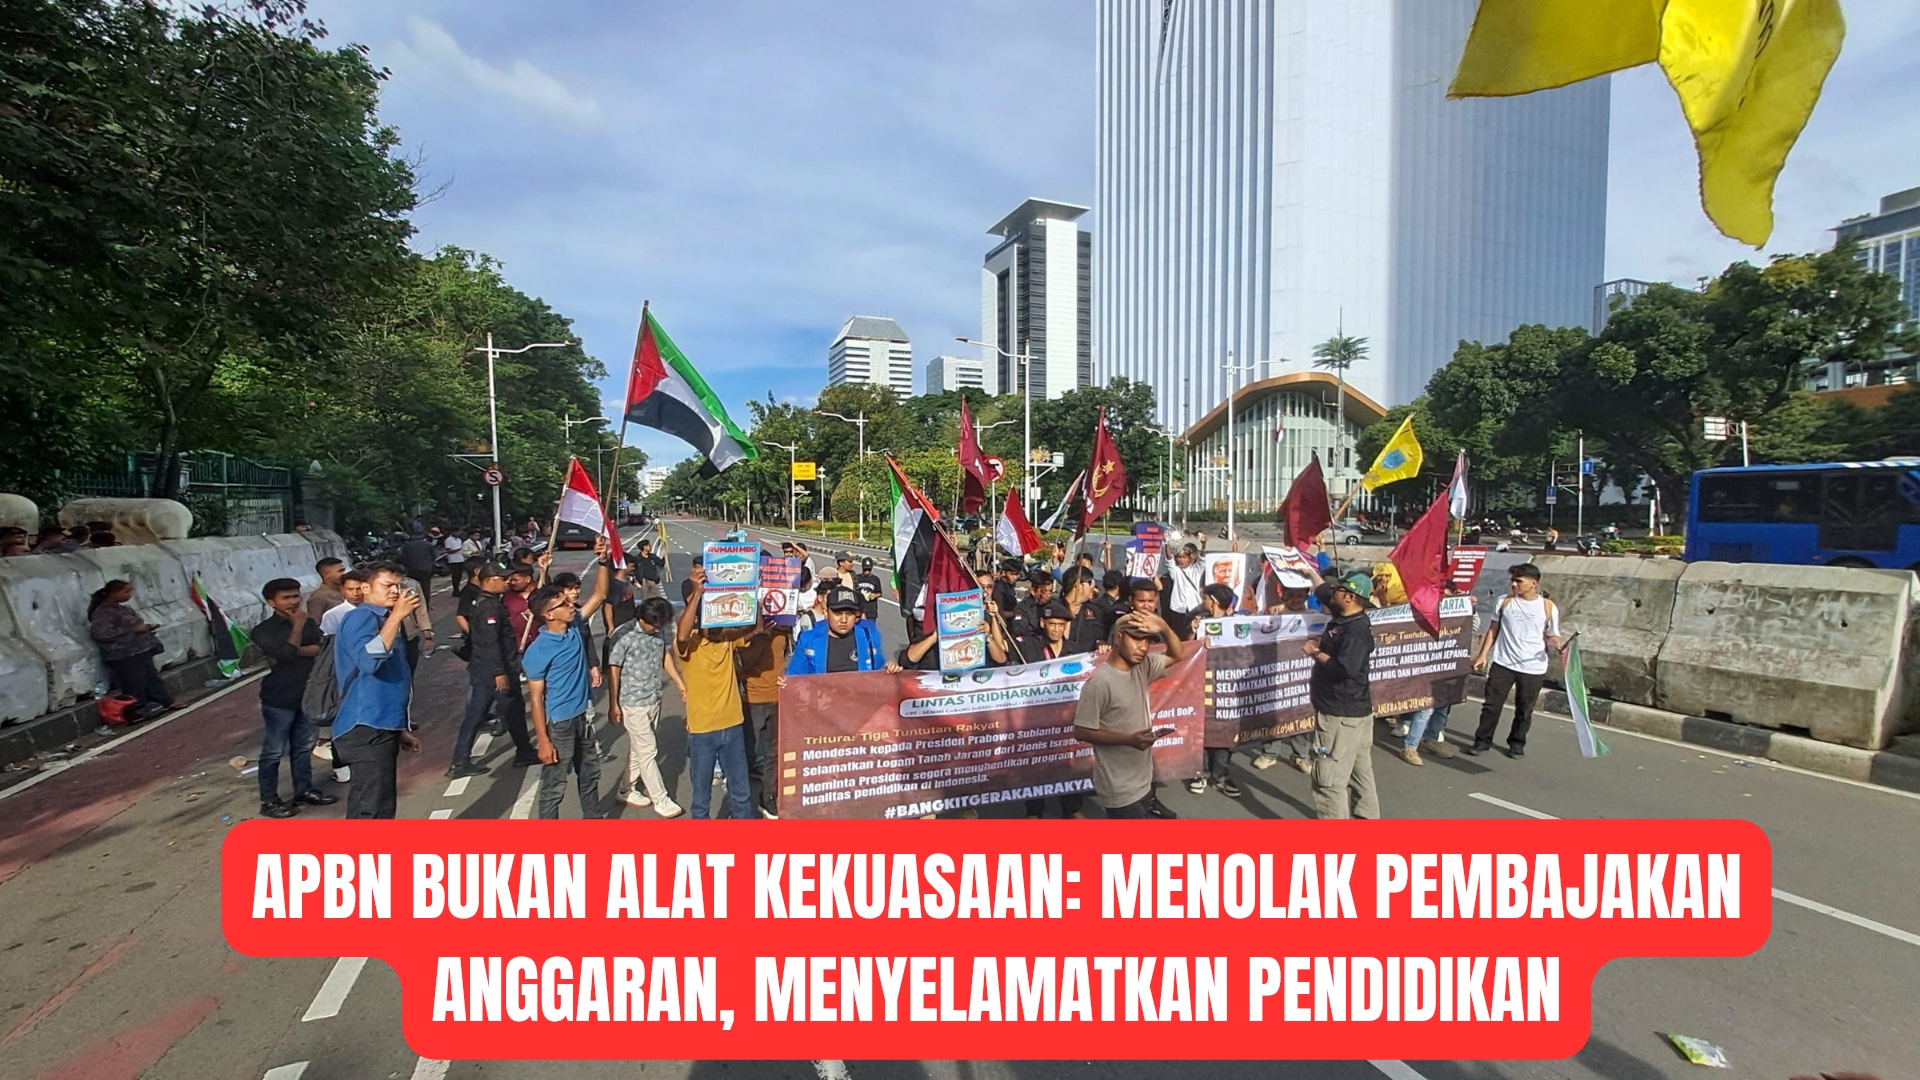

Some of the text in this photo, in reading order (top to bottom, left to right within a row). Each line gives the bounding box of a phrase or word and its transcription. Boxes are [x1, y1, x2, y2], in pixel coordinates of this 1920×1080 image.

[1216, 666, 1259, 681] MENDESAK
[1260, 660, 1290, 674] PRESIDEN
[1378, 645, 1401, 657] SEGERA
[1216, 678, 1267, 694] SELAMATKAN
[1268, 674, 1289, 686] LOGAM
[1400, 653, 1430, 665] AMERIKA
[912, 682, 1080, 709] LINTAS TRIDHARMA JAK
[1216, 694, 1253, 708] MEMINTA
[1254, 689, 1283, 703] PRESIDEN
[1284, 684, 1305, 696] SEGERA
[1216, 705, 1254, 719] KUALITAS
[803, 745, 867, 761] Mendesak
[870, 741, 912, 757] kepada
[915, 736, 965, 750] Presiden
[968, 732, 1014, 746] Prabowo
[1017, 725, 1061, 739] Subianto
[1157, 707, 1175, 719] dari
[804, 720, 1000, 745] Tritura: Tiga Tuntutan Rakyat
[802, 777, 856, 794] Meminta
[858, 771, 909, 787] Presiden
[912, 768, 951, 783] segera
[954, 757, 1029, 775] menghentikan
[1031, 752, 1074, 767] program
[803, 760, 874, 777] Selamatkan
[877, 757, 915, 772] Logam
[918, 752, 951, 768] Tanah
[954, 748, 991, 762] Jarang
[994, 744, 1015, 756] dari
[1017, 740, 1047, 753] Zionis
[802, 774, 990, 806] kualitas pendidikan di Indonesia.
[884, 778, 1094, 819] #BANGKITGERAKANRAKYA
